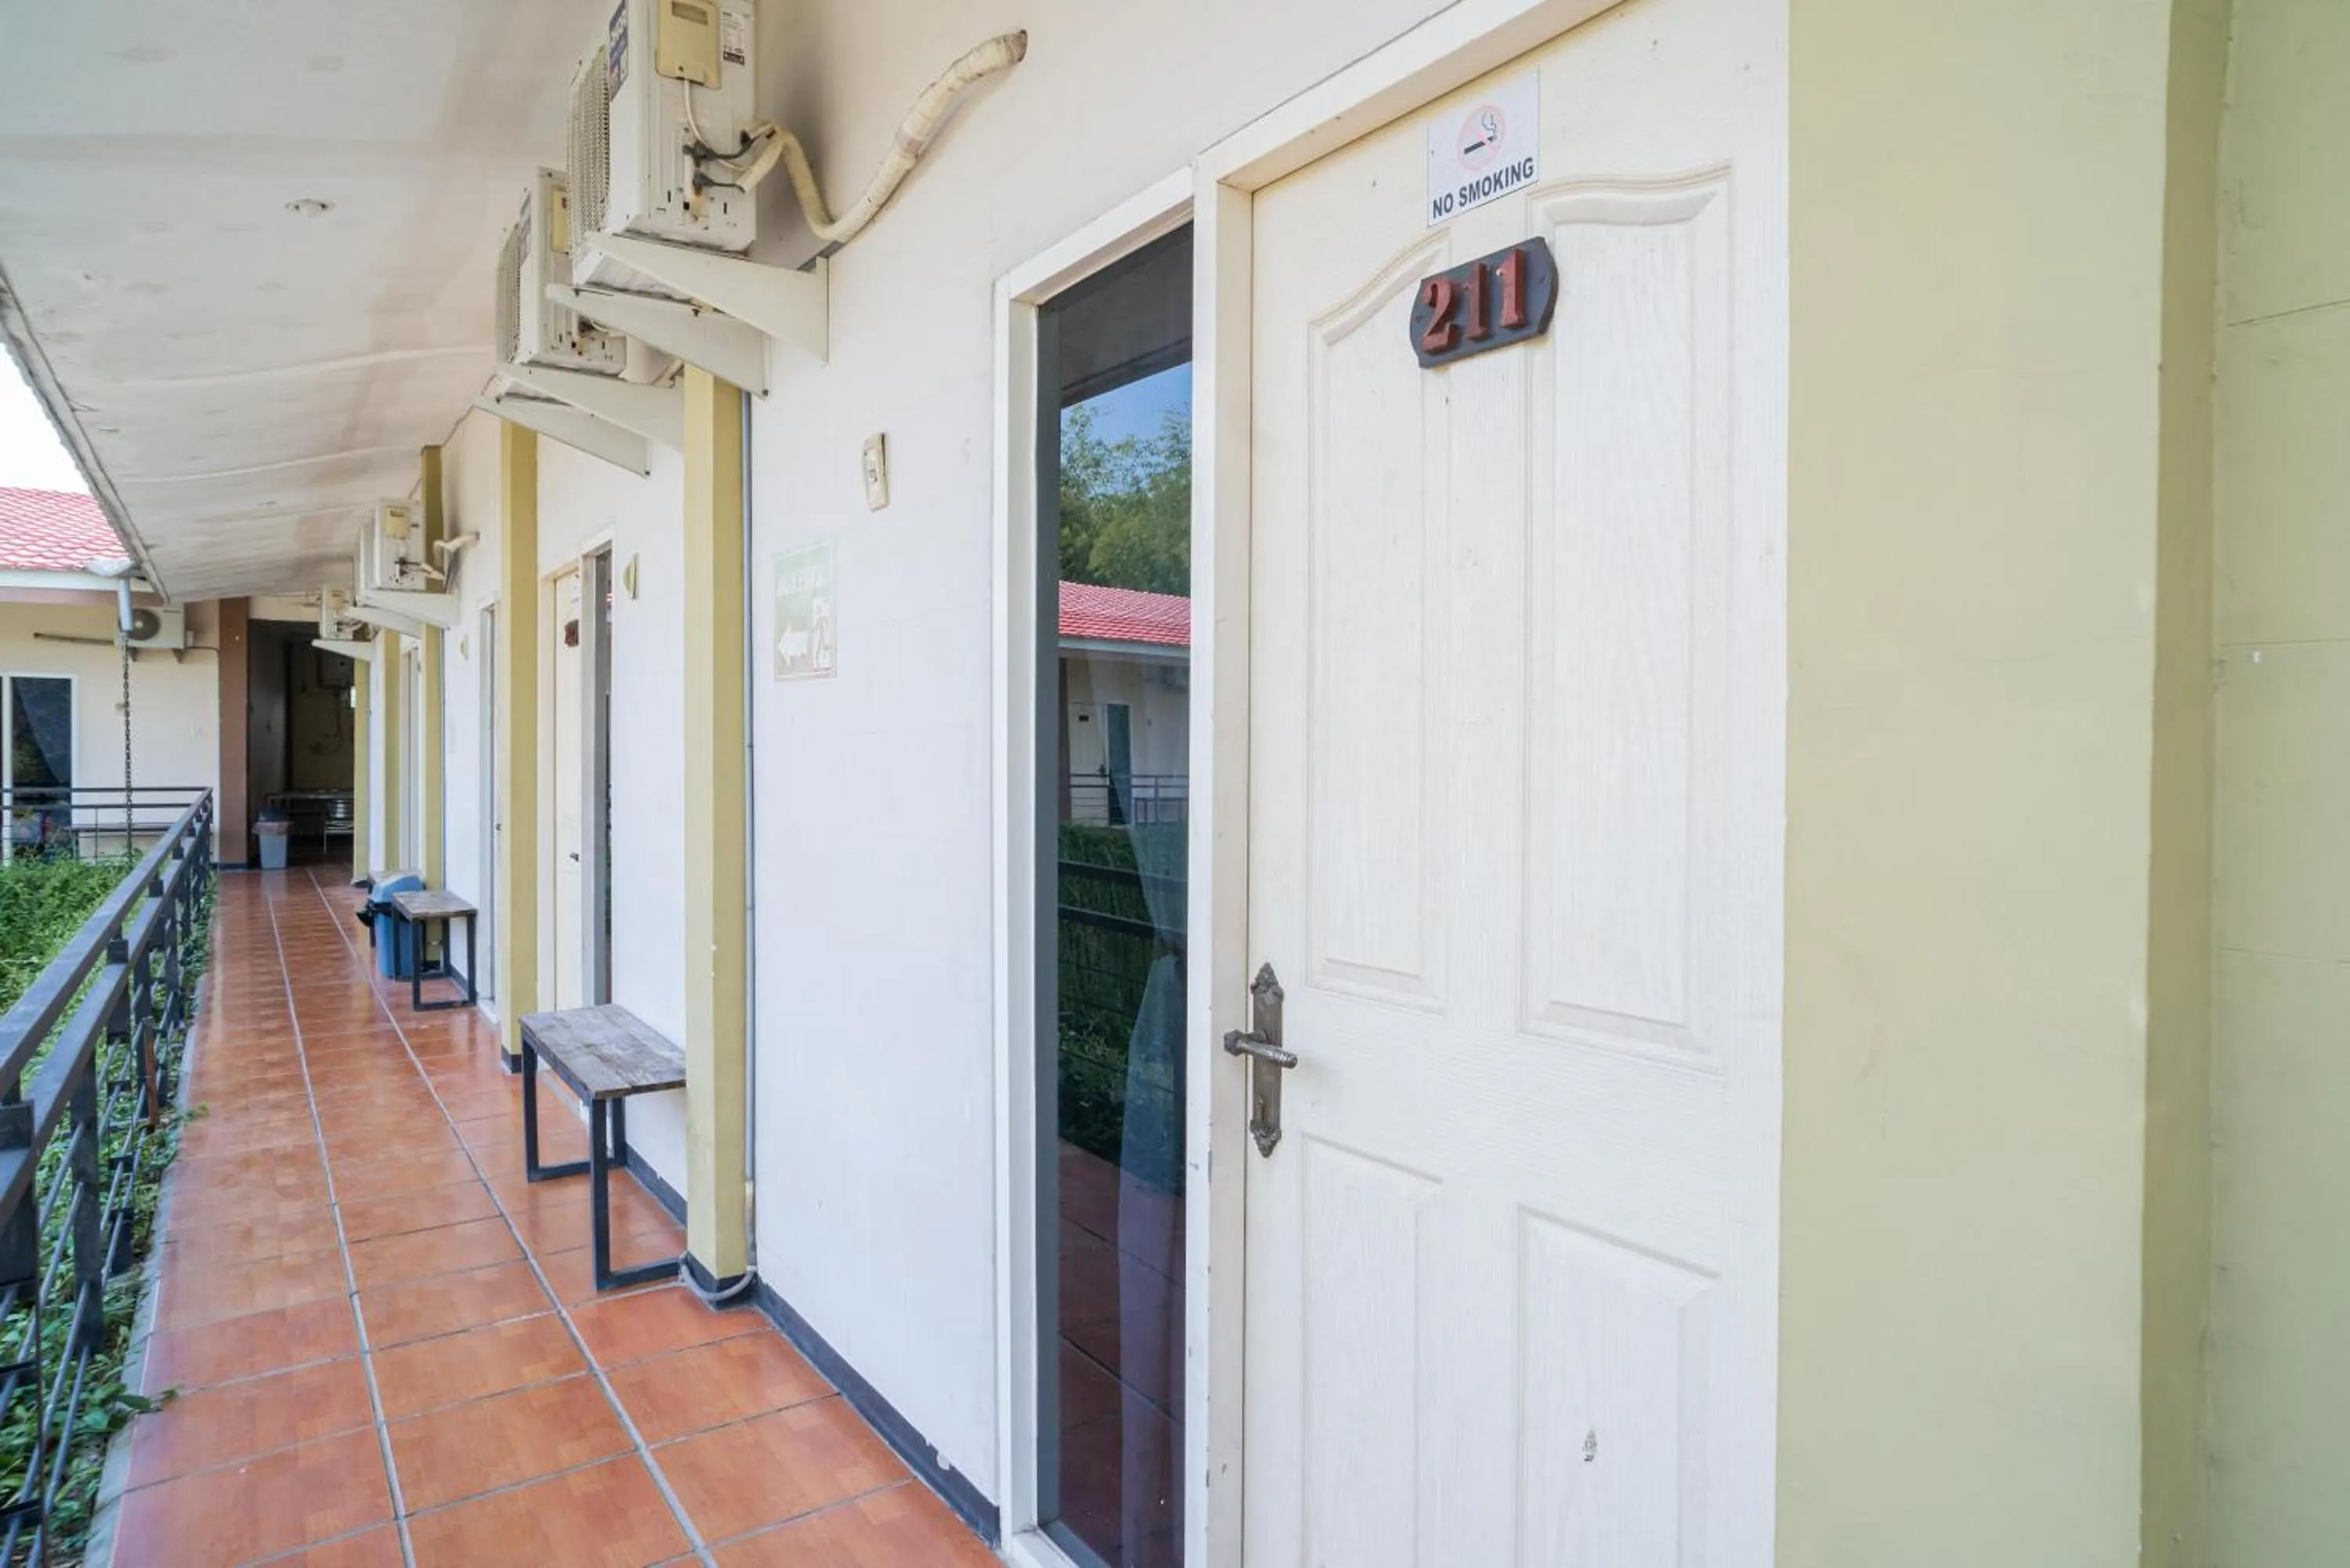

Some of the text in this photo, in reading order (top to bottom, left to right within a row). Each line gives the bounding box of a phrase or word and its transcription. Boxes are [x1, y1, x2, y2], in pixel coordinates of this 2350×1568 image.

[1433, 157, 1534, 219] NO SMOKING
[1422, 247, 1527, 355] 211
